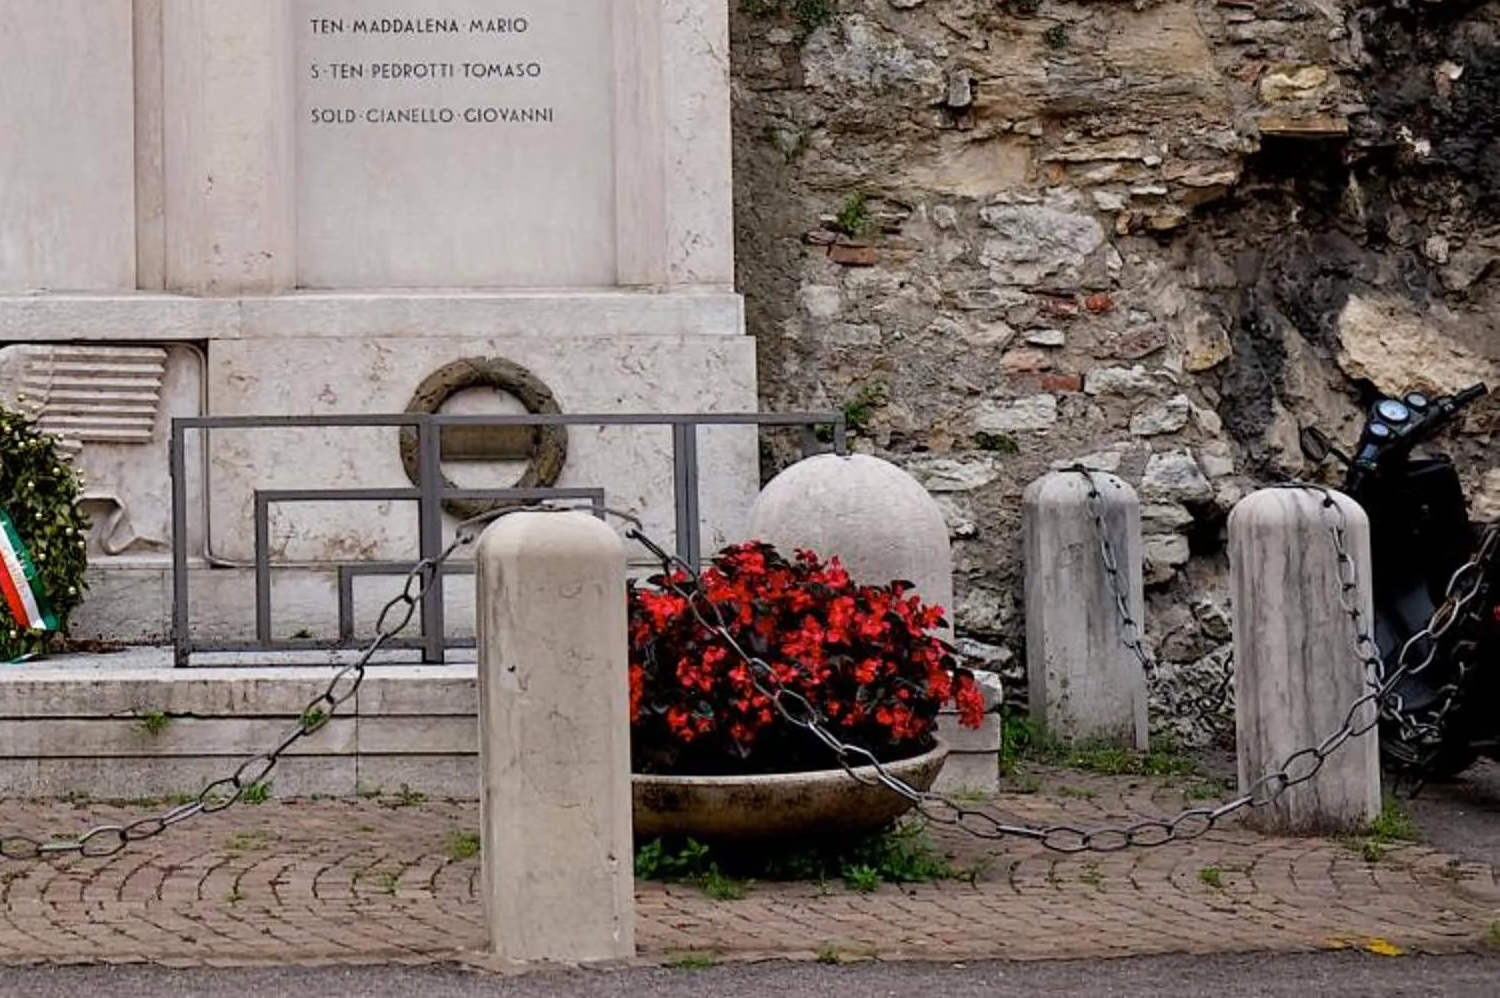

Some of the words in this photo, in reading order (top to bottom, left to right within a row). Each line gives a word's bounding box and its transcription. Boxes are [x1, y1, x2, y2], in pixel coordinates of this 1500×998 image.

[309, 18, 344, 35] TEN
[352, 18, 460, 35] MADDALENA
[468, 18, 529, 35] MARIO
[309, 62, 320, 79] S
[329, 62, 364, 79] TEN
[371, 62, 455, 79] PEDROTTI
[460, 62, 542, 79] TOMASO
[310, 108, 356, 125] SOLD
[462, 108, 554, 125] GIOVANNI
